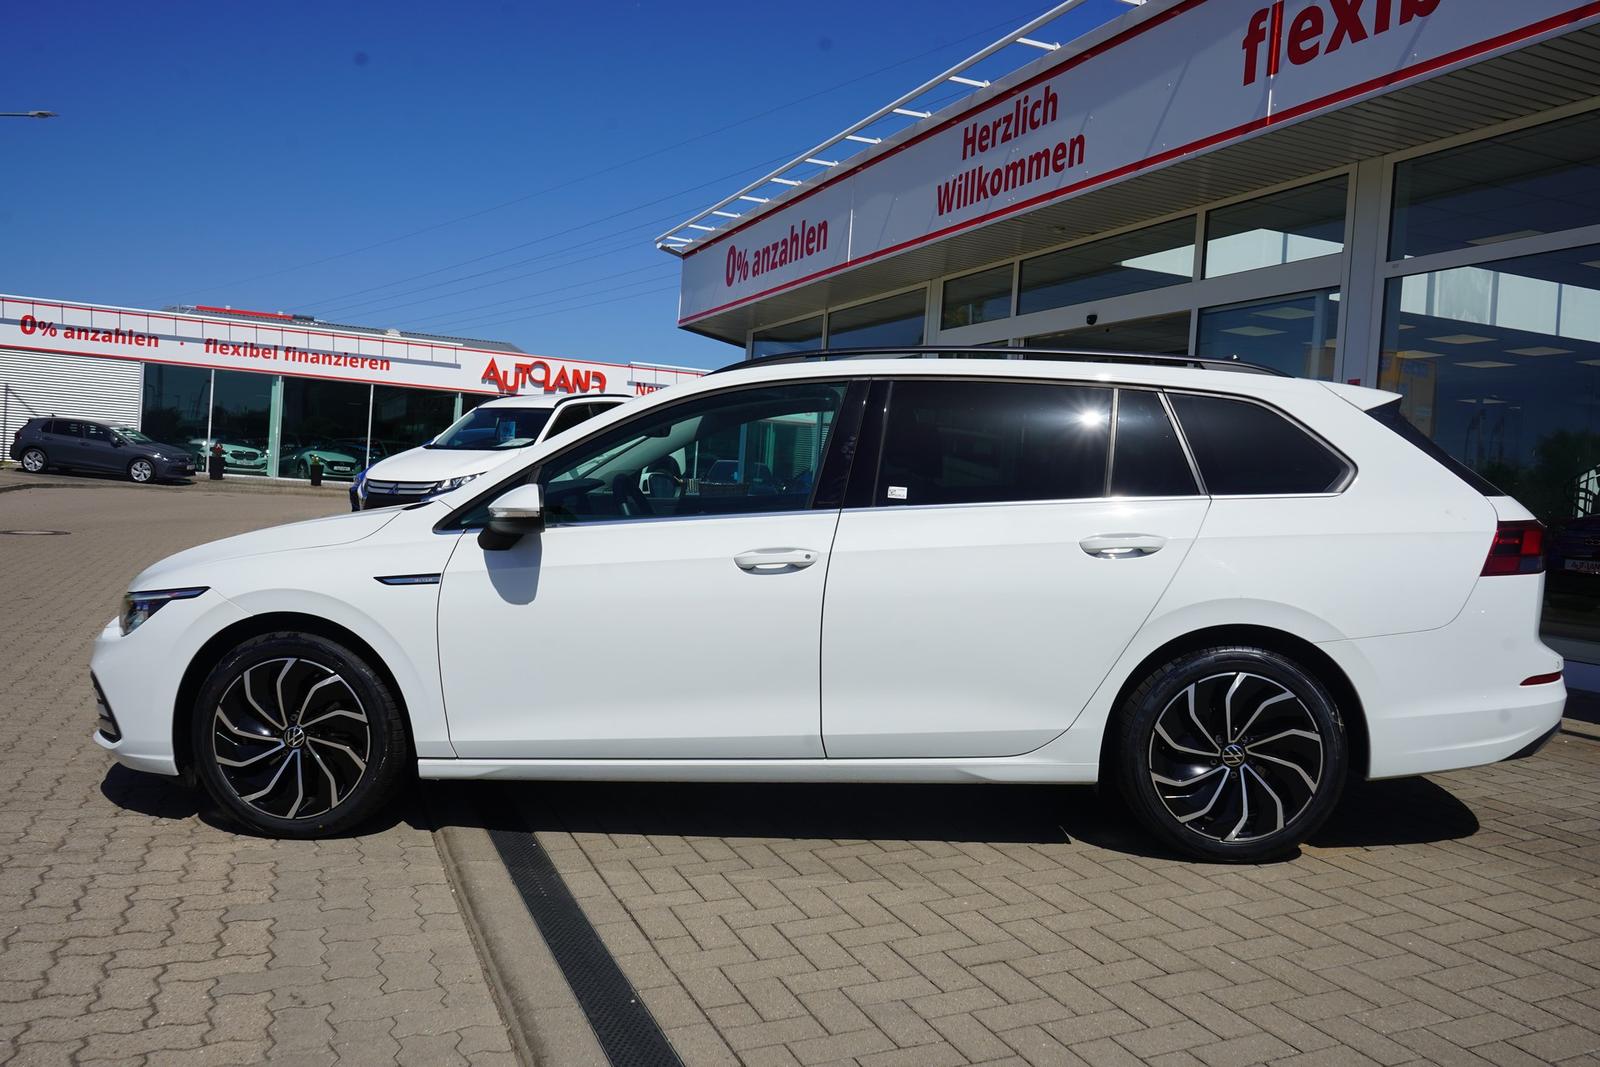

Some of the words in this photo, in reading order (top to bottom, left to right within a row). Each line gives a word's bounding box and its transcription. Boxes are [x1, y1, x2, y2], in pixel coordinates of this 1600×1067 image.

[962, 85, 1058, 160] Herzlich
[937, 133, 1085, 216] Willkommen
[725, 244, 749, 287] 0%
[752, 220, 828, 278] anzahlen
[20, 314, 57, 337] 0%
[63, 328, 159, 347] anzahlen
[204, 338, 278, 360] flexibel
[284, 346, 391, 371] finanzieren
